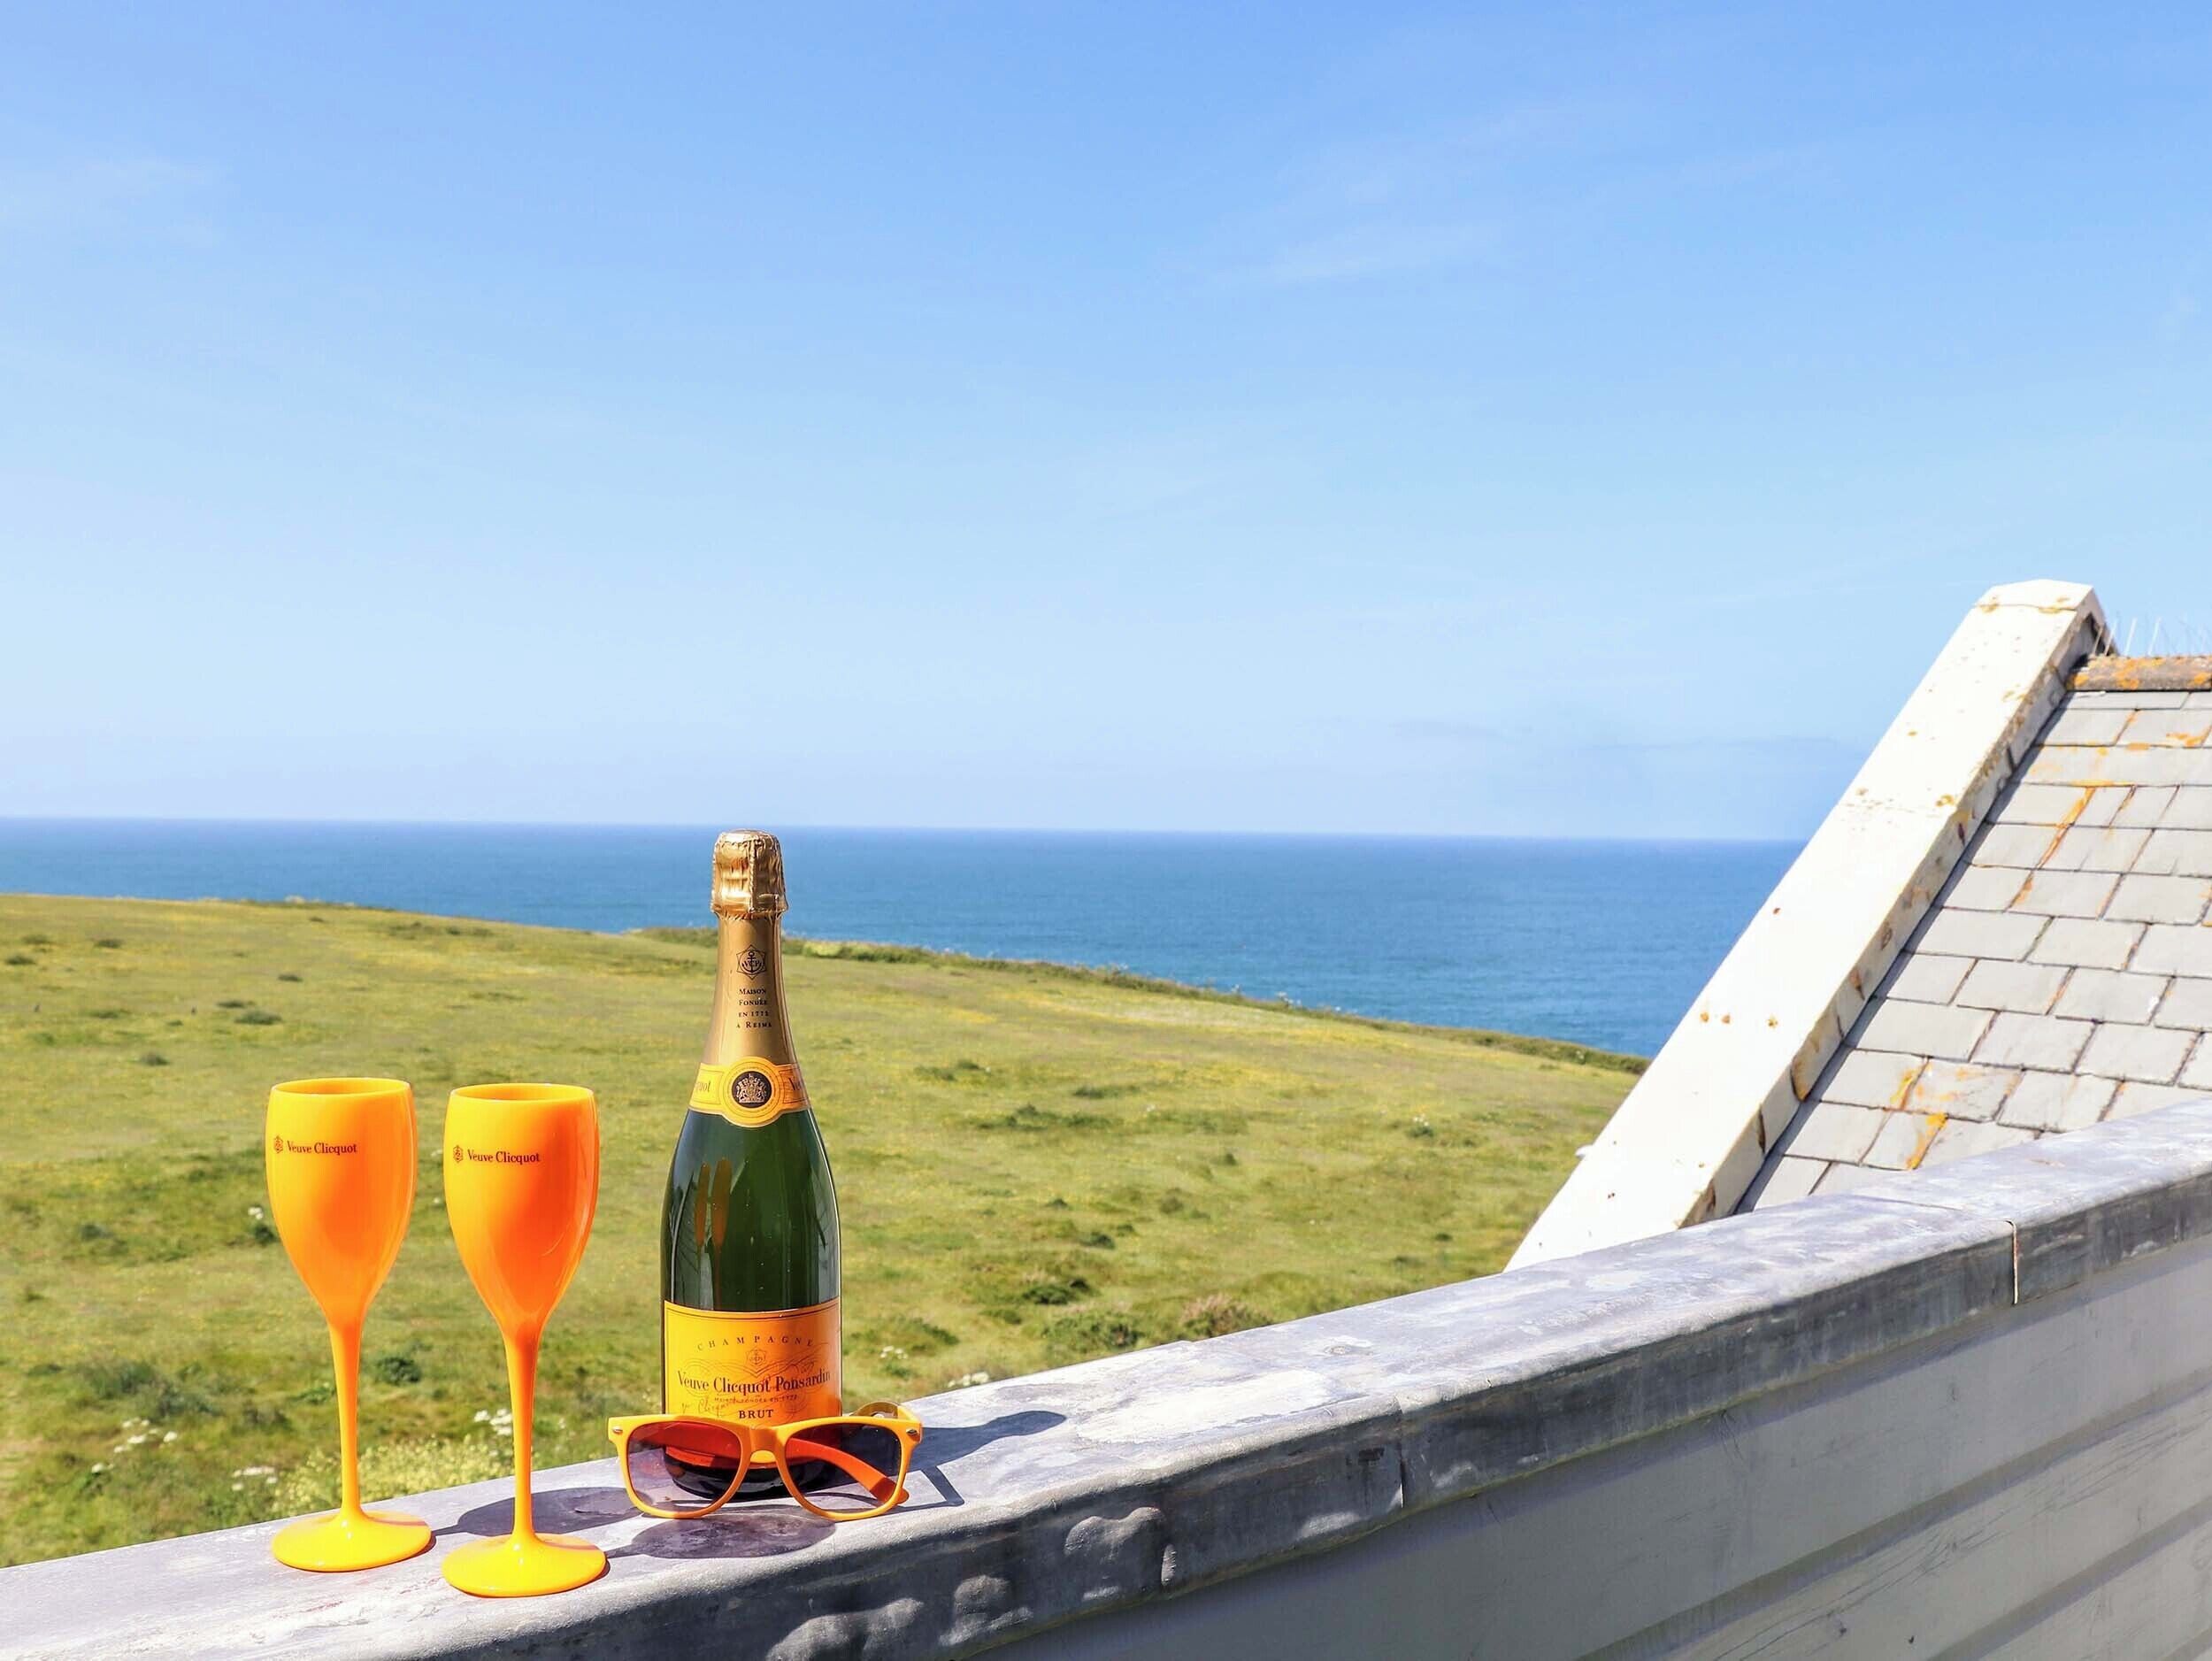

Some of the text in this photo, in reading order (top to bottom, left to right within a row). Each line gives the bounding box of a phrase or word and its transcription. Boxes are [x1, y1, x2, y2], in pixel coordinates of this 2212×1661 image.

[287, 1140, 357, 1156] Veuve Clicquot
[467, 1149, 540, 1165] Veuve Clicquot
[697, 1334, 814, 1351] CHAMPAGNE
[677, 1370, 710, 1391] Veuve
[713, 1377, 772, 1396] Clicquot
[775, 1367, 832, 1392] Ponsardin
[738, 1409, 774, 1419] BRUT
